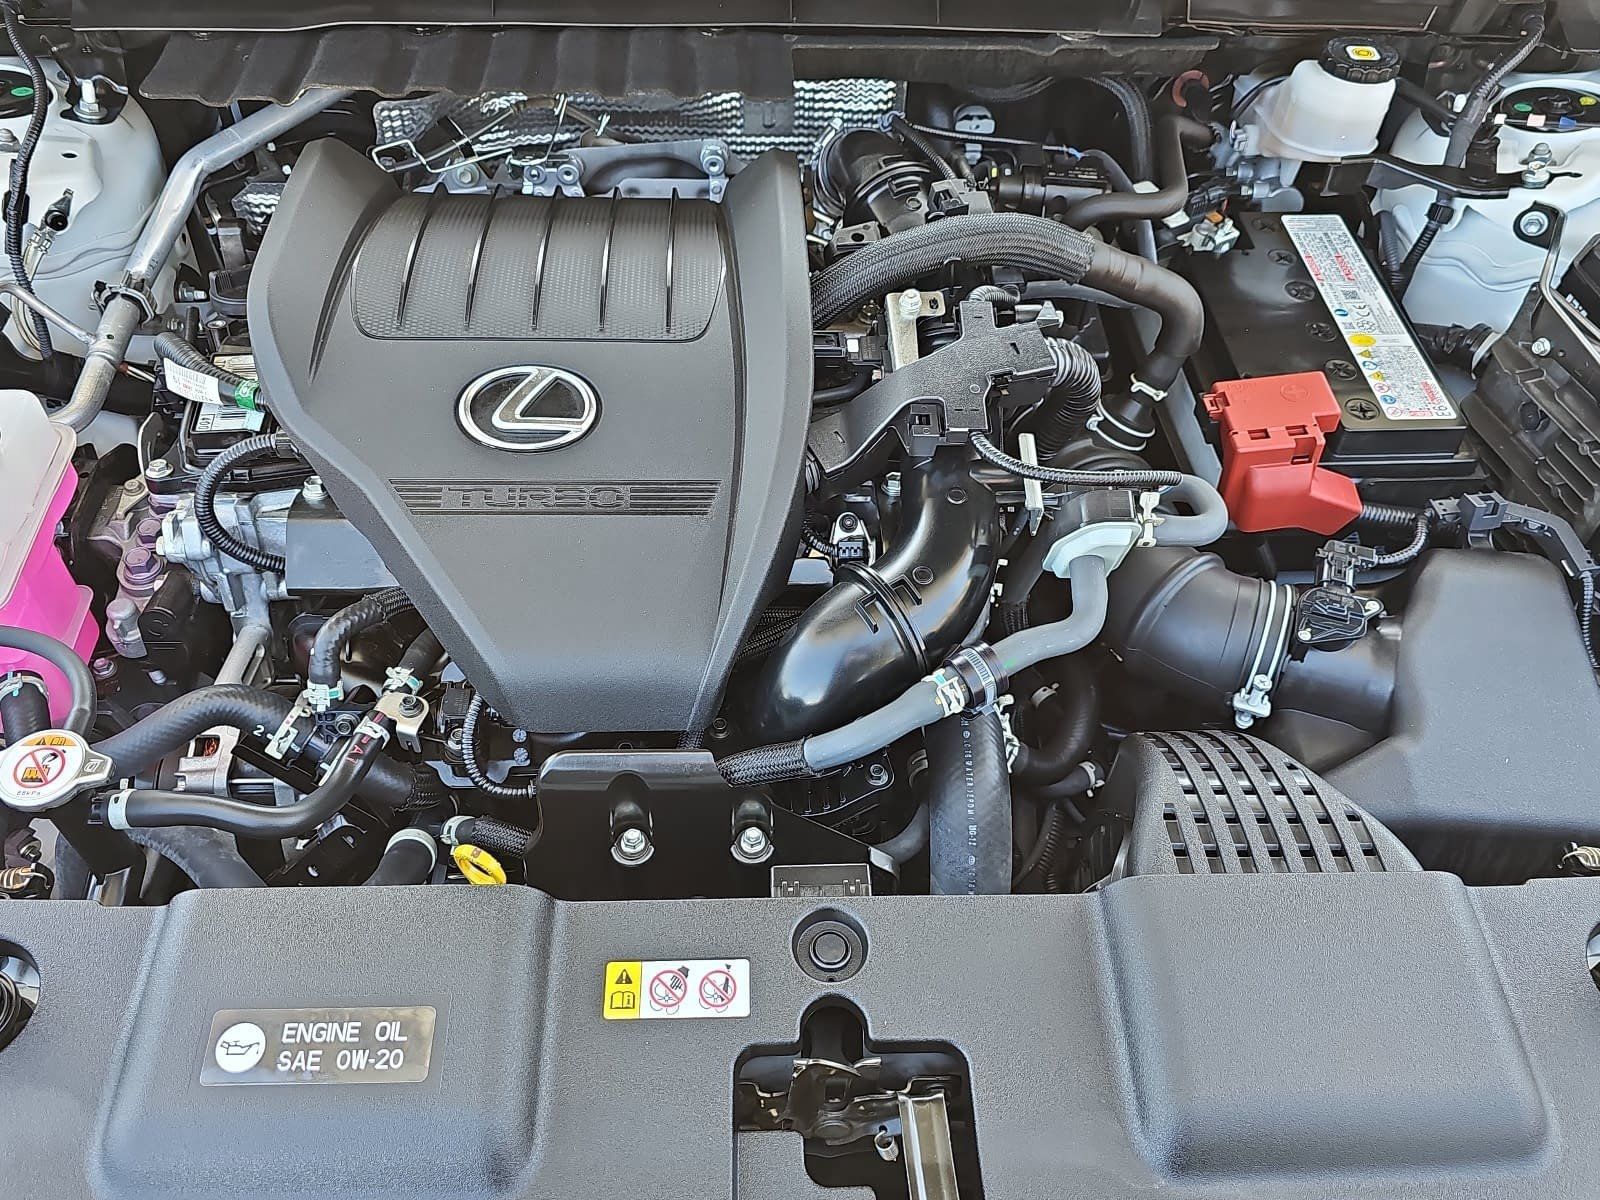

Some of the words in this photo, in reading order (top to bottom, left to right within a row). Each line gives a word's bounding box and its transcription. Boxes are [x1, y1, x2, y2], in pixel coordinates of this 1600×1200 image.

[446, 485, 627, 510] TURBO
[281, 1021, 362, 1044] ENGINE
[374, 1021, 408, 1043] OIL
[276, 1050, 324, 1072] SAE
[336, 1048, 404, 1071] 0W-20
